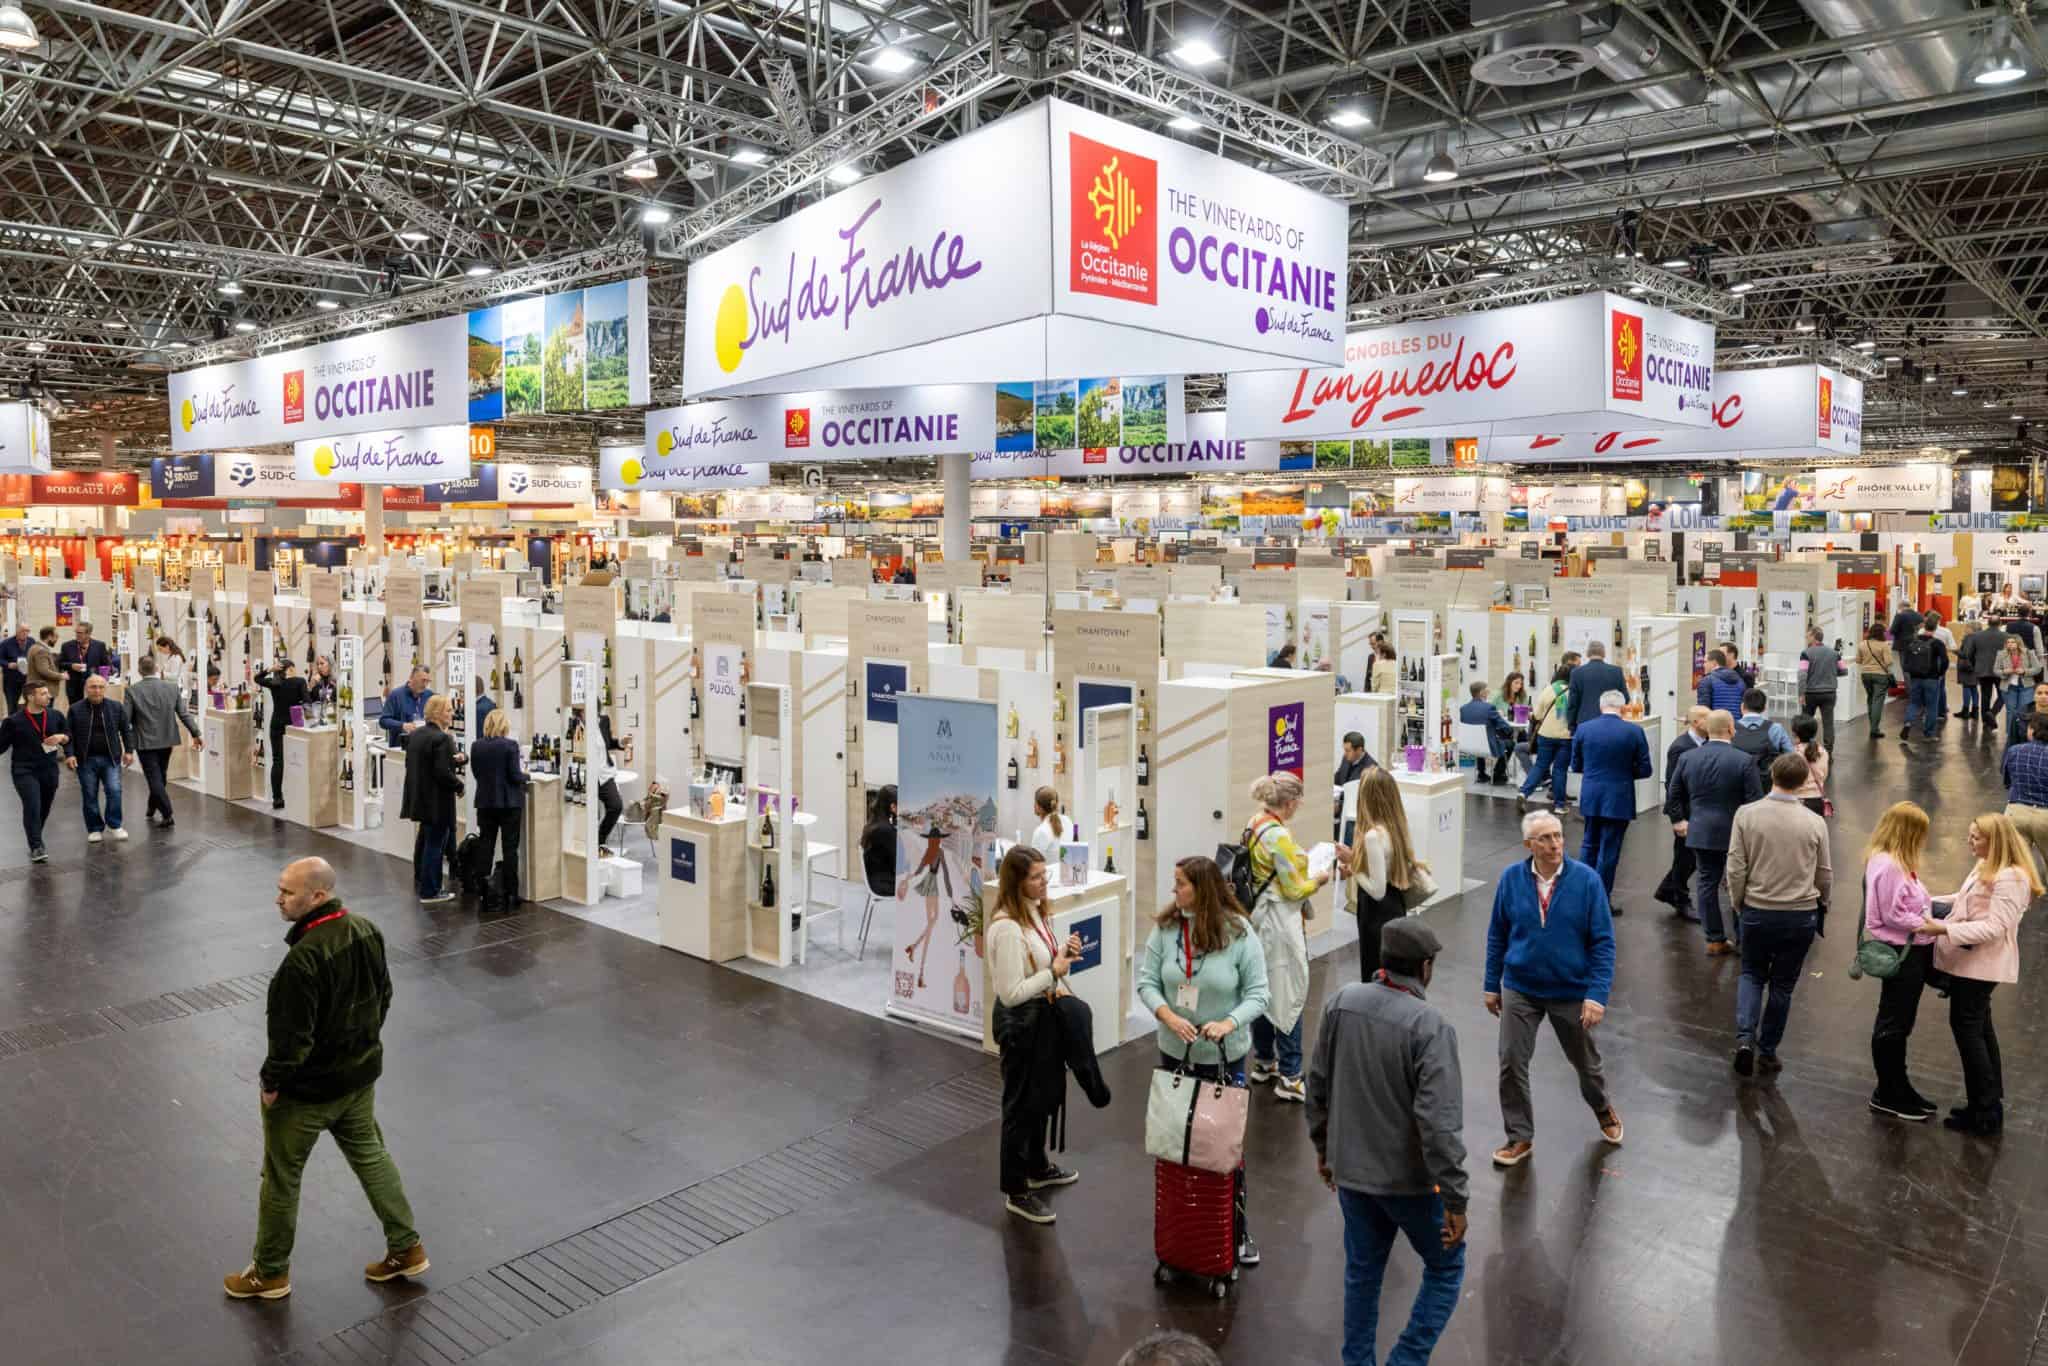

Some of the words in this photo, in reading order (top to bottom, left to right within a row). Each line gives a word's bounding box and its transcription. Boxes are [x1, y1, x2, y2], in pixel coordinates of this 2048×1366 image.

[1168, 188, 1197, 218] THE
[1202, 199, 1282, 246] VINEYARDS
[1286, 228, 1304, 251] OF
[739, 251, 796, 350] Sud
[798, 256, 839, 320] de
[839, 199, 982, 330] France
[1081, 251, 1149, 282] Occitanie
[1168, 226, 1336, 312] OCCITANIE
[1266, 307, 1286, 336] Sud
[1286, 319, 1301, 334] de
[1300, 313, 1334, 343] France
[1425, 332, 1453, 350] DU
[1645, 332, 1657, 346] THE
[1658, 335, 1691, 358] VINEYARDS
[1691, 344, 1700, 359] OF
[313, 363, 326, 377] THE
[326, 359, 366, 376] VINEYARDS
[367, 354, 377, 369] OF
[1646, 354, 1711, 392] OCCITANIE
[191, 391, 208, 425] Sud
[208, 398, 223, 417] de
[222, 383, 261, 423] France
[315, 368, 435, 421] OCCITANIE
[822, 405, 835, 416] THE
[837, 401, 878, 415] VINEYARDS
[879, 399, 893, 411] OF
[822, 413, 959, 448] OCCITANIE
[1832, 405, 1861, 431] OCCITANIE
[469, 434, 491, 455] 10
[668, 424, 693, 450] Sud
[693, 428, 711, 445] de
[711, 416, 758, 448] France
[330, 441, 362, 473] Sud
[361, 446, 385, 467] de
[384, 436, 444, 471] France
[1119, 439, 1246, 465] OCCITANIE
[1458, 444, 1478, 463] 10
[46, 485, 104, 496] BORDEAUX
[531, 479, 583, 489] SUD-OUEST
[806, 468, 822, 488] G
[1857, 481, 1892, 492] RHÔNE
[1895, 483, 1933, 492] VALLEY
[709, 682, 737, 696] PUJOL
